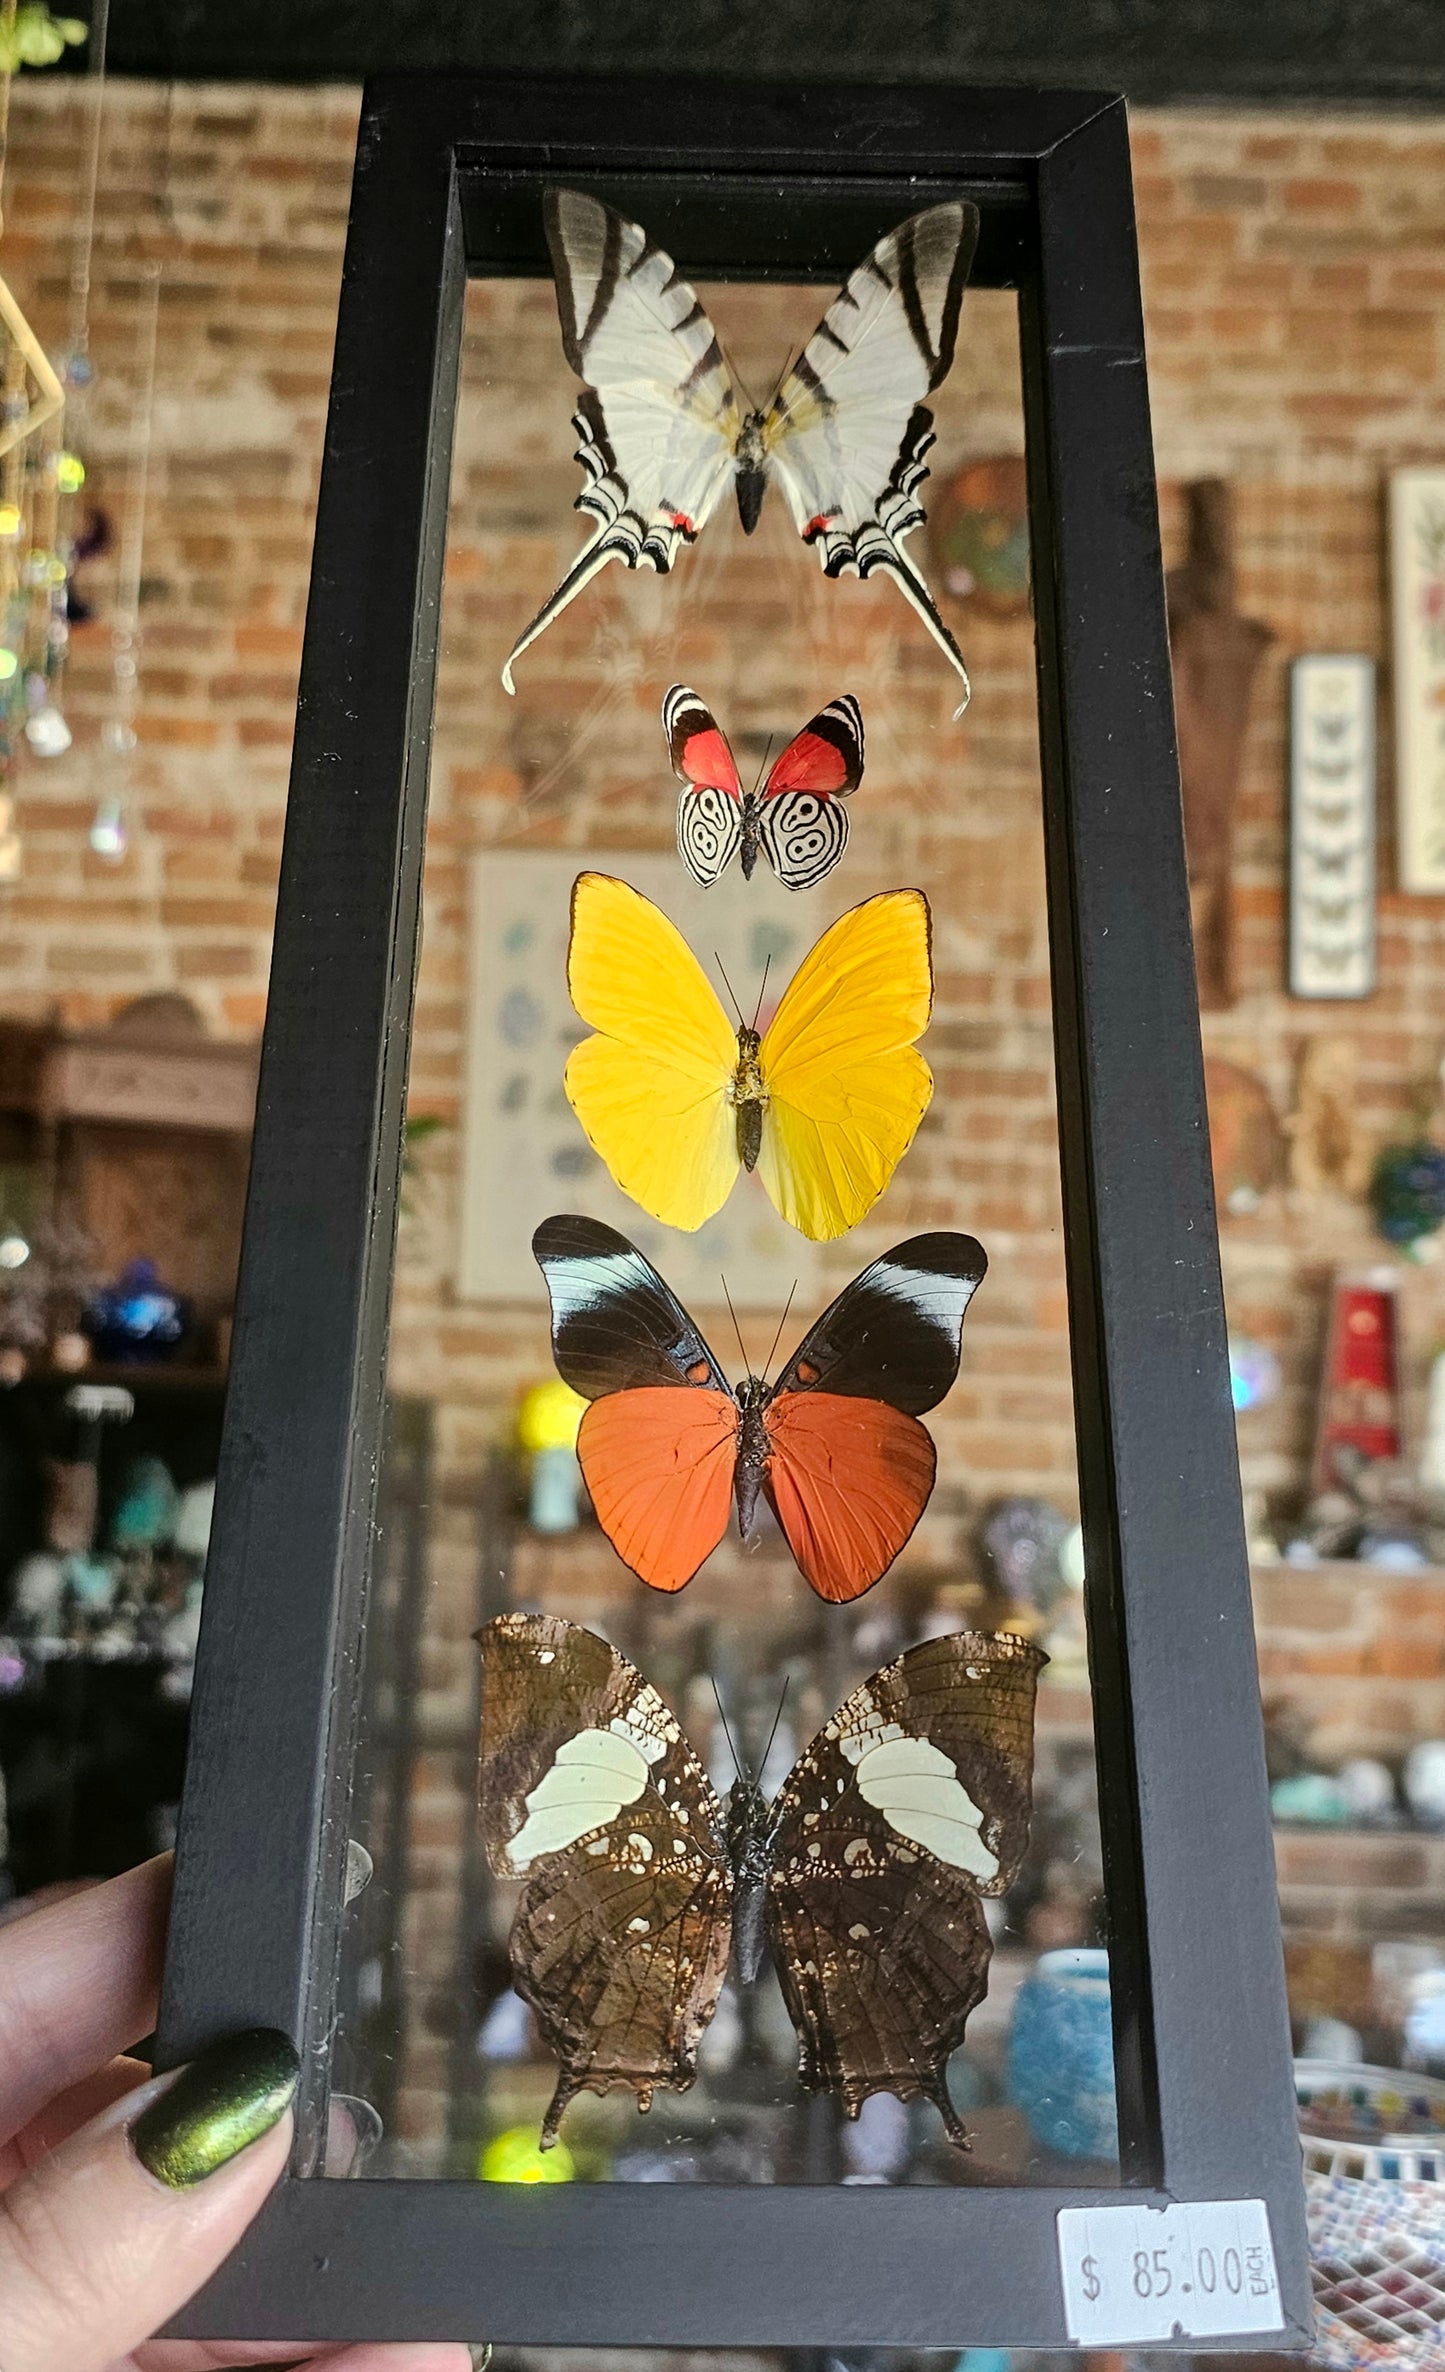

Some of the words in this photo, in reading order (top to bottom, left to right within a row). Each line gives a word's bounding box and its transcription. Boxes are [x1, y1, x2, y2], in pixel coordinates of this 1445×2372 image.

[1081, 2254, 1101, 2301] $
[1133, 2247, 1242, 2298] 85.00
[1246, 2245, 1269, 2296] EACH
